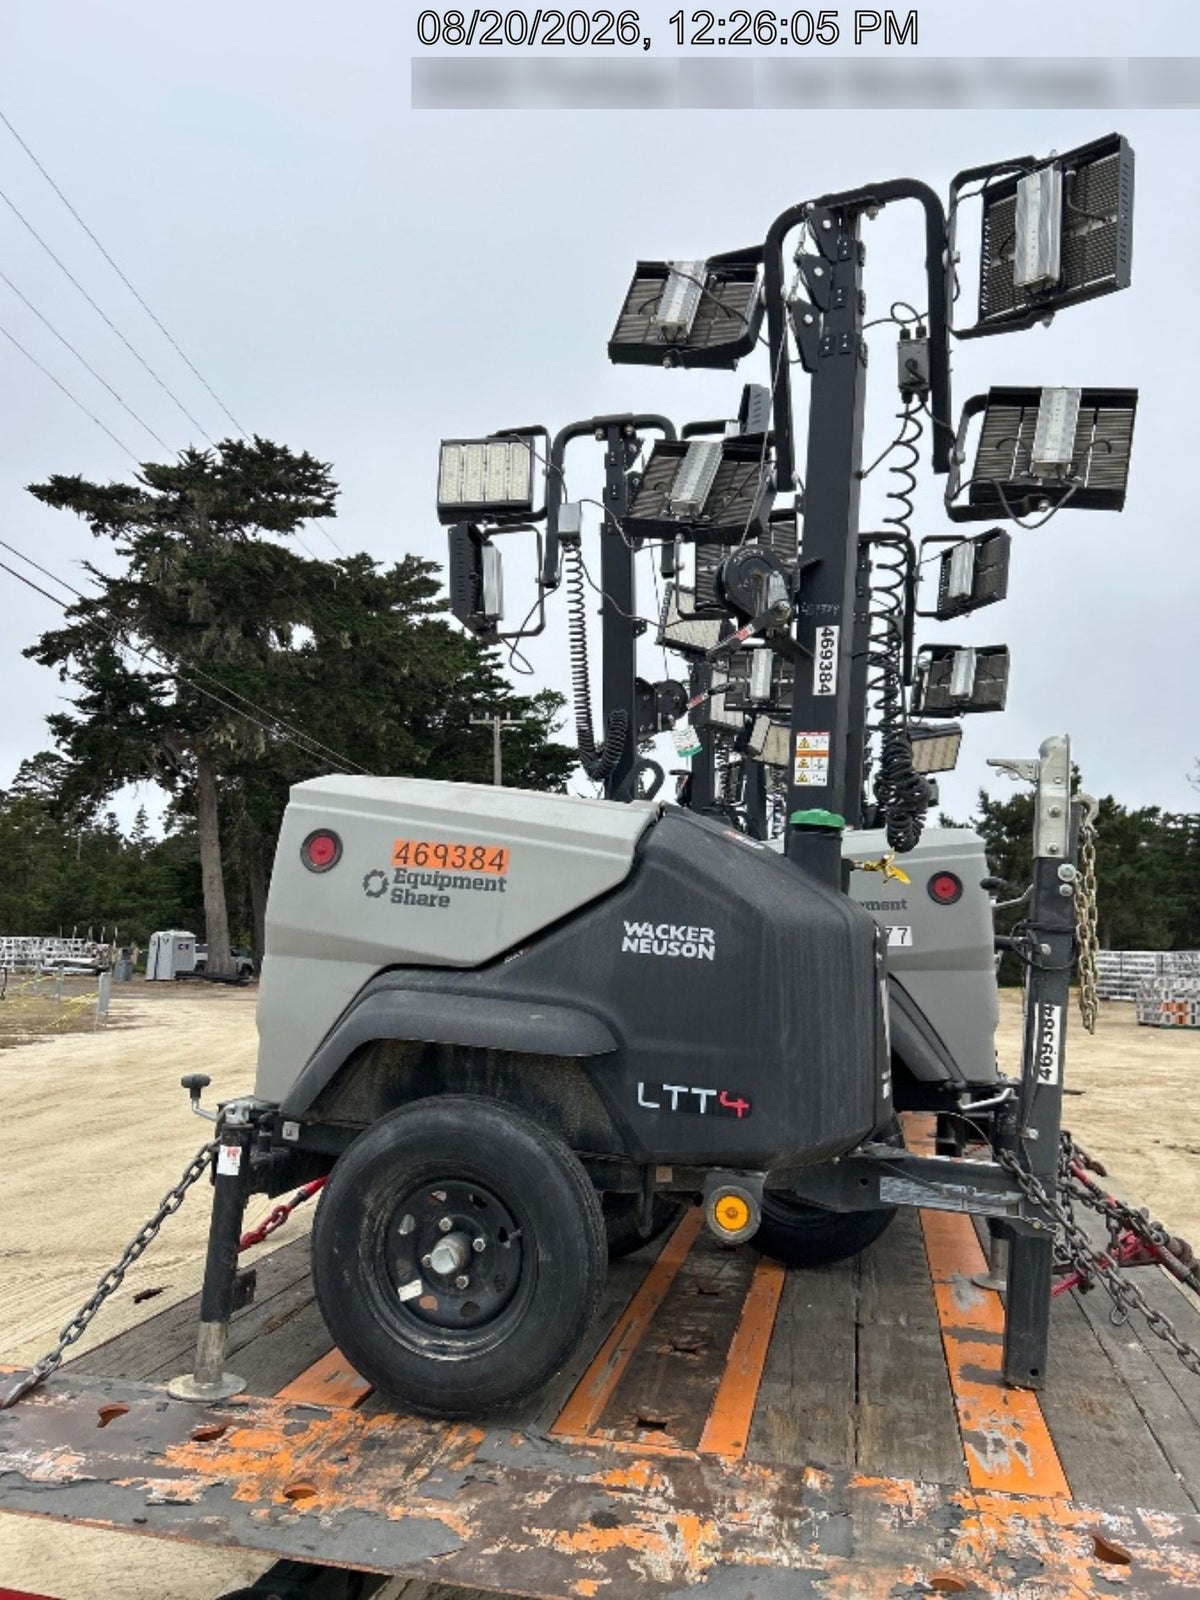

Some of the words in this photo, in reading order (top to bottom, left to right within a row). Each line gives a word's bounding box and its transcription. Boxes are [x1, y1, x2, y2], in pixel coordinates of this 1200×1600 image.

[817, 626, 835, 695] 469384
[394, 841, 506, 872] 469384
[393, 867, 507, 892] Equipment
[390, 888, 451, 908] Share
[623, 920, 716, 944] WACKER
[621, 936, 716, 961] NEUSON
[1039, 1003, 1056, 1081] 469384
[637, 1081, 750, 1118] LTT4
